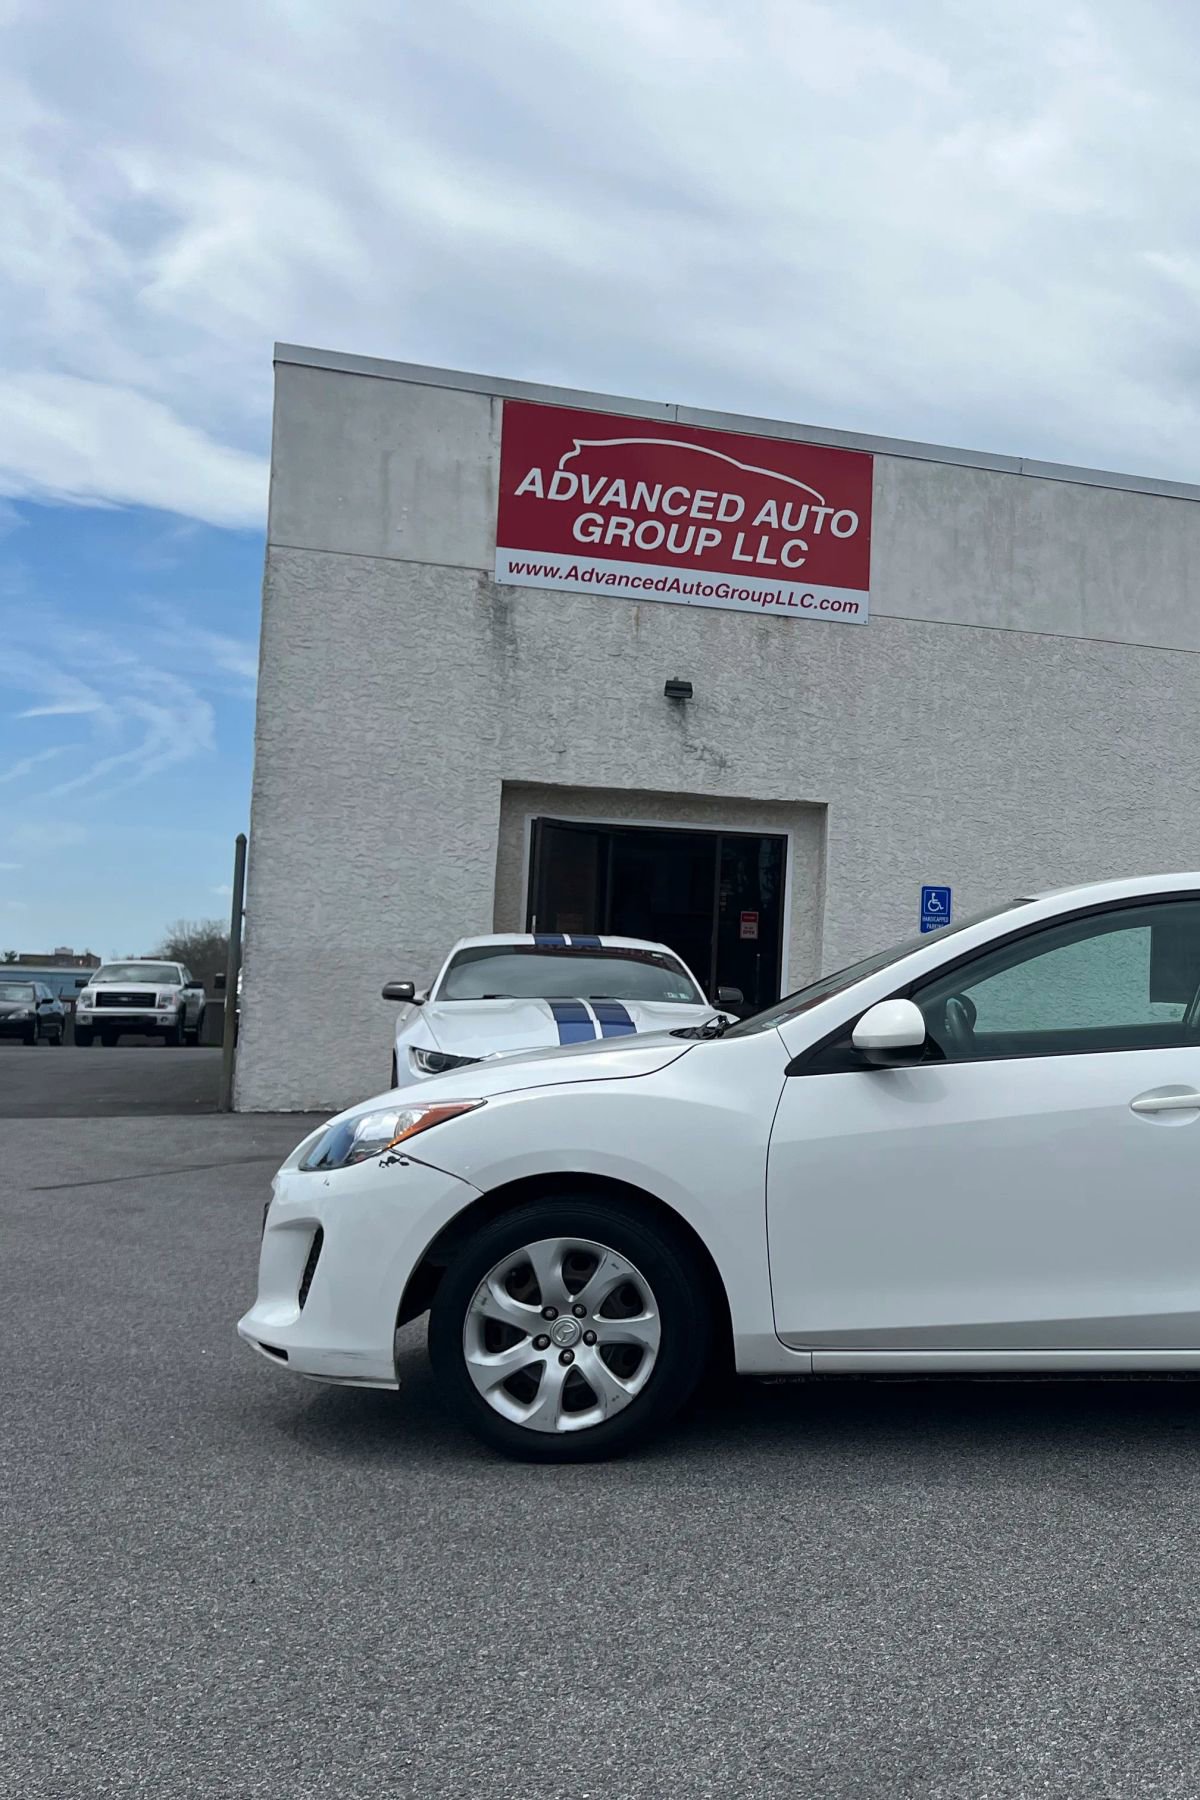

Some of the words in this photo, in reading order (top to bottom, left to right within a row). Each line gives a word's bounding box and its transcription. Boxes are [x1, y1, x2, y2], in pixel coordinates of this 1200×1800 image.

[514, 467, 745, 523] ADVANCED
[752, 499, 859, 539] AUTO
[572, 512, 723, 556] GROUP
[731, 532, 809, 569] LLC
[508, 561, 860, 615] www.AdvancedAutoGroupLLC.com
